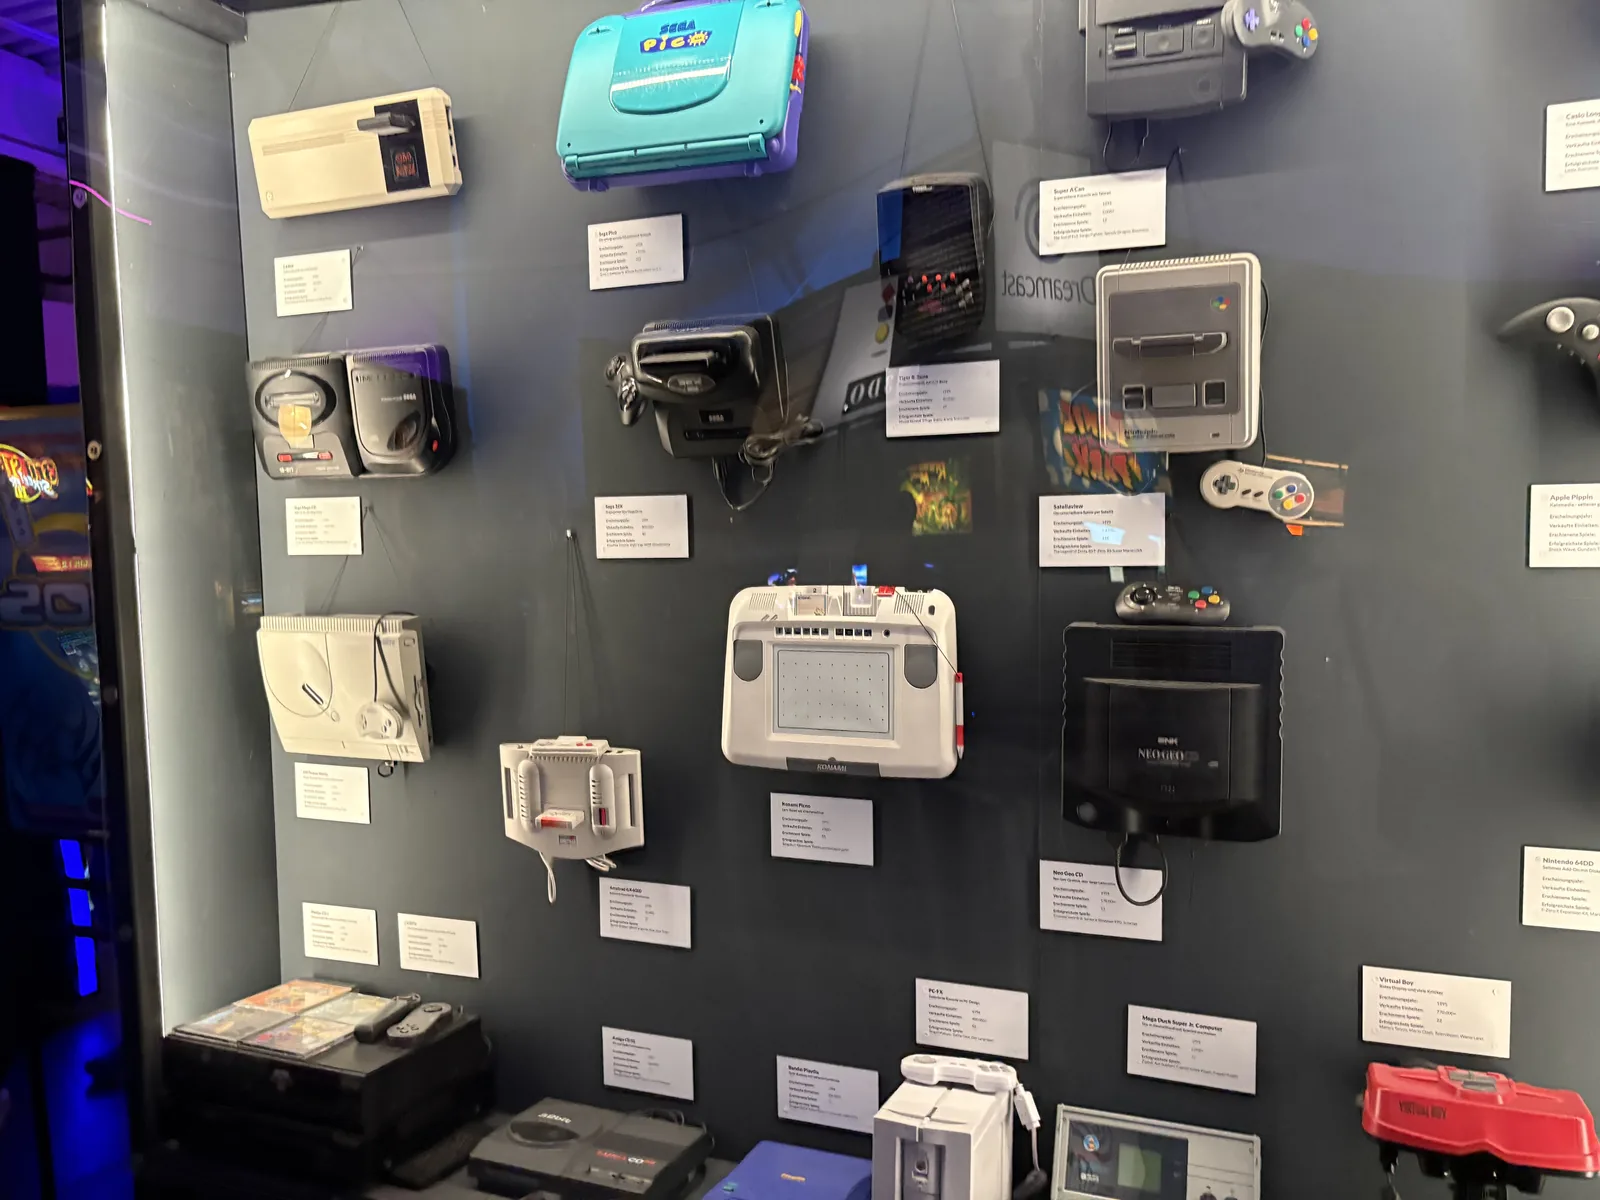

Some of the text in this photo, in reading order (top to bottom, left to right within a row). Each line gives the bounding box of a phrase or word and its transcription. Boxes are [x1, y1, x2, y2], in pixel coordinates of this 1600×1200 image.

[659, 20, 696, 35] SEGA
[1566, 112, 1584, 120] Casio
[817, 763, 847, 772] KONAMI
[1379, 976, 1401, 985] Virtual
[1379, 994, 1418, 1003] Erscheinungsjahr:
[1142, 1015, 1157, 1023] Mega
[1158, 1017, 1171, 1025] Duck
[1172, 1019, 1188, 1027] Super
[1196, 1022, 1223, 1032] Computer
